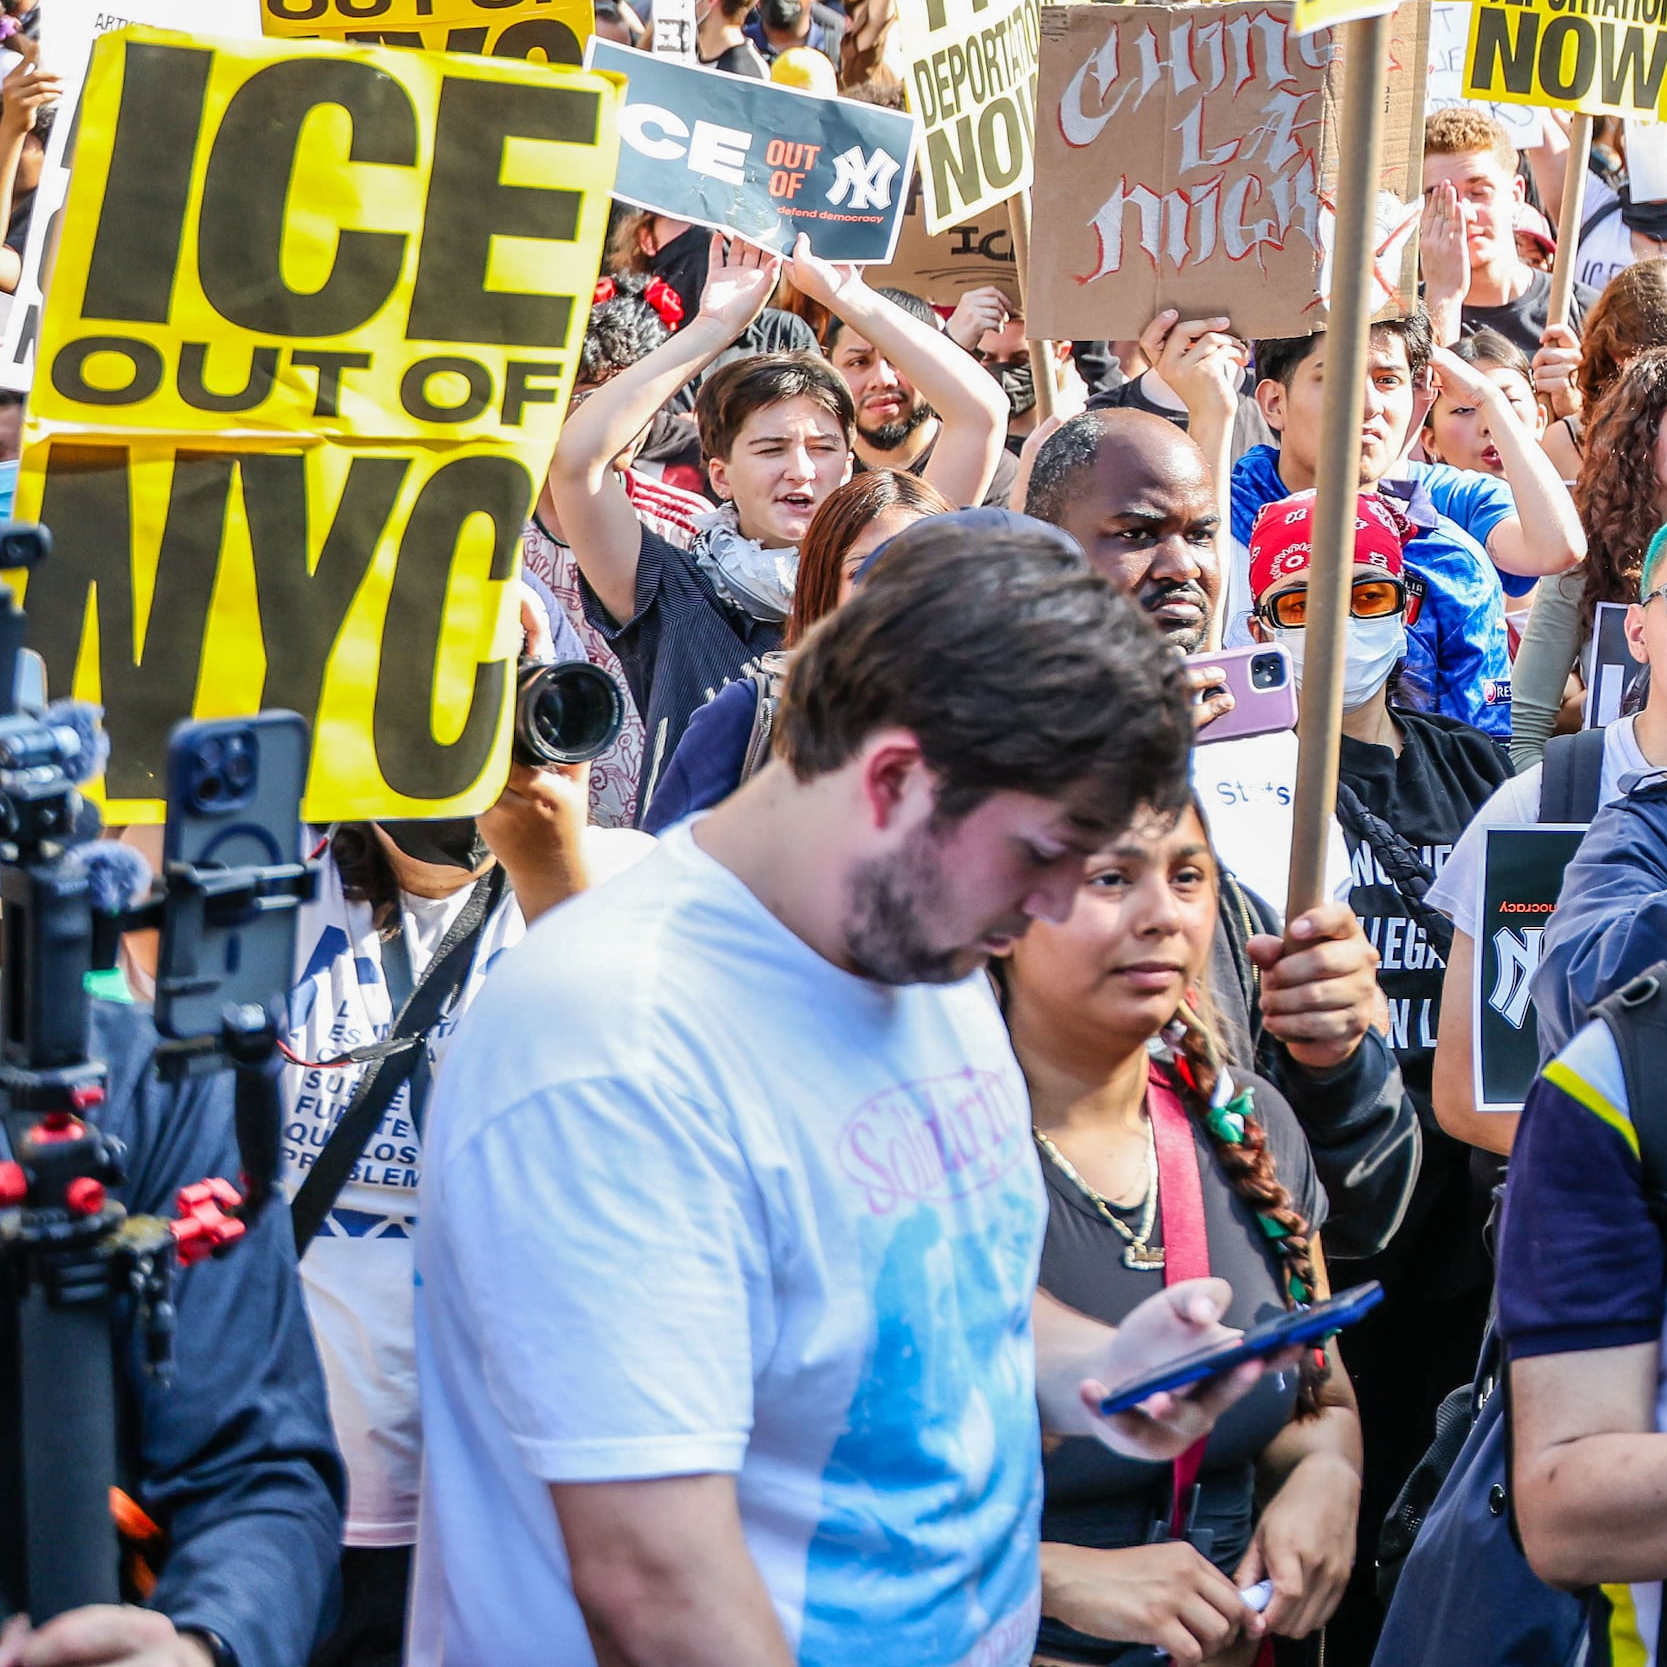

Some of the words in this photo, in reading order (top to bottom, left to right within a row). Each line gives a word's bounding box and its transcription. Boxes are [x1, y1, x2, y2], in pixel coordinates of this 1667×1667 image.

[616, 103, 753, 187] CE
[765, 138, 820, 170] OUT
[1171, 86, 1329, 176] LA
[81, 40, 602, 349] ICE
[767, 168, 803, 198] OF
[777, 206, 816, 221] defend
[819, 208, 885, 224] democracy
[51, 336, 372, 418] OUT
[399, 355, 563, 425] OF
[24, 443, 533, 799] NYC
